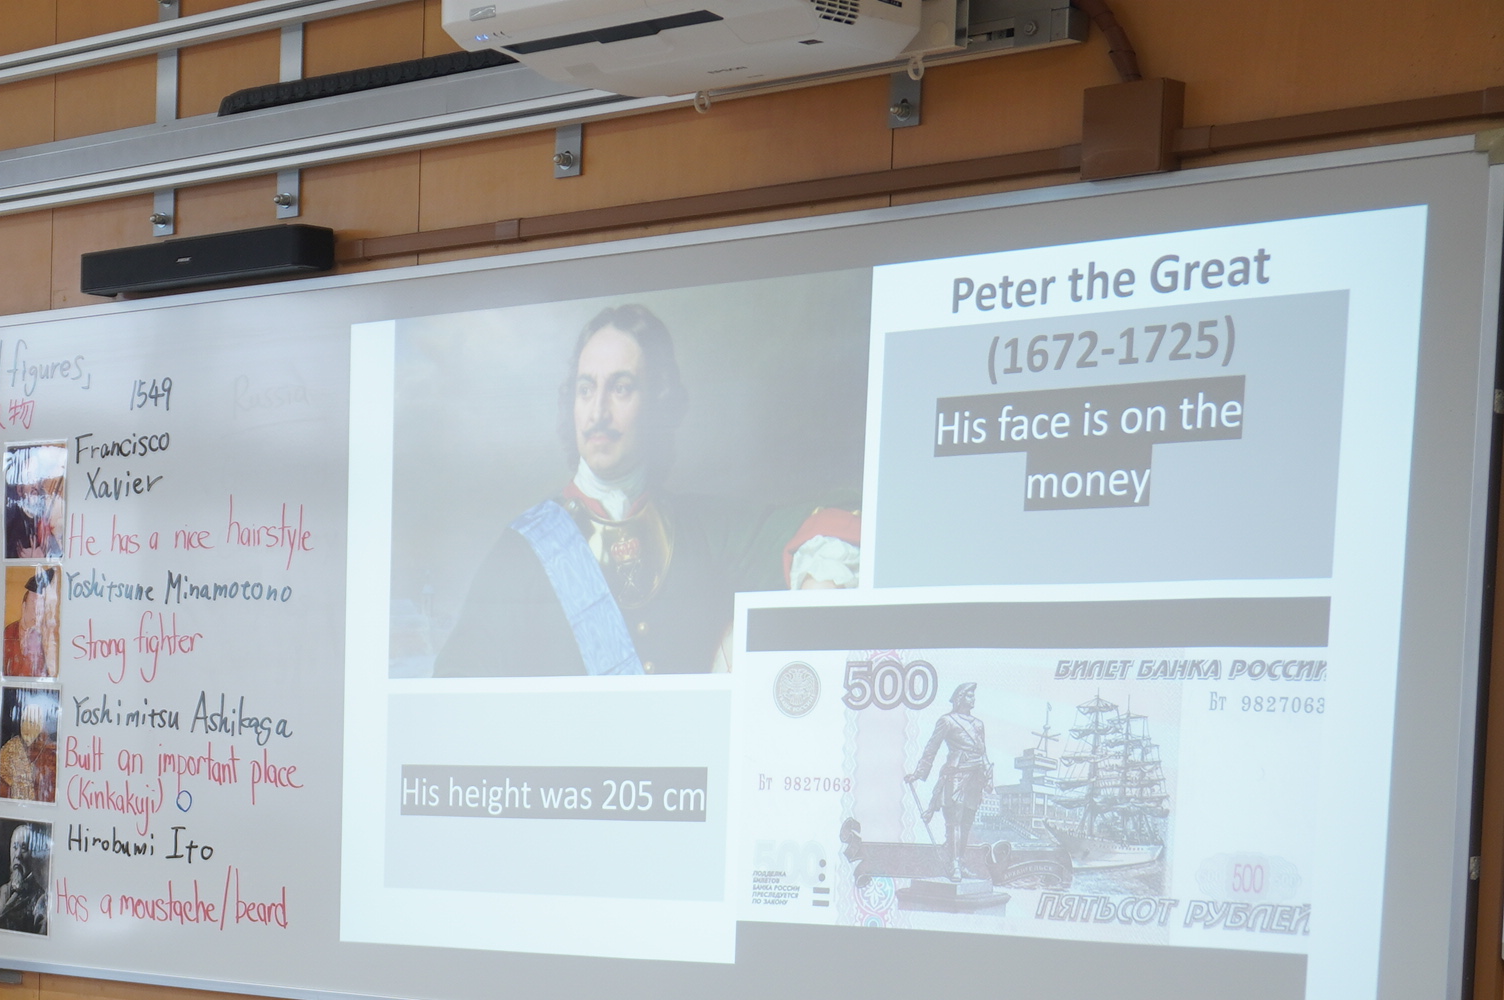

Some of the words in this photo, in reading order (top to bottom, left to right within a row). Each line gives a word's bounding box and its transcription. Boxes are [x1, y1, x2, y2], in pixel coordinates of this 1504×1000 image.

[952, 275, 1056, 314] Peter
[1067, 261, 1136, 303] the
[1150, 247, 1272, 295] Great
[987, 314, 1236, 385] (1672-1725)
[129, 377, 173, 412] 1549
[936, 409, 987, 446] His
[997, 405, 1070, 442] face
[1082, 402, 1109, 437] is
[1120, 405, 1167, 434] on
[1179, 392, 1243, 431] the
[75, 432, 170, 464] Francisco
[85, 467, 163, 500] Xavier
[1026, 468, 1151, 504] money
[68, 512, 101, 559] He
[110, 513, 141, 555] has
[149, 530, 160, 551] a
[174, 523, 215, 551] nice
[226, 496, 315, 571] hairstyle
[65, 567, 155, 602] Yoshitsune
[164, 569, 292, 605] Minamotono
[71, 618, 127, 684] strong
[133, 610, 204, 684] fighter
[841, 659, 939, 711] 500
[1054, 659, 1135, 681] БИЛЕТ
[1136, 659, 1222, 681] БАНКА
[1241, 695, 1325, 714] 9827063
[72, 693, 180, 731] Yoshimitsu
[190, 690, 293, 746] Ashikaga
[64, 735, 104, 773] Built
[117, 748, 143, 775] an
[157, 740, 240, 796] important
[249, 747, 304, 806] place
[784, 776, 852, 793] 9827063
[66, 773, 164, 837] (Kinkakuji)
[402, 777, 439, 807] His
[448, 777, 532, 815] height
[540, 786, 592, 809] was
[601, 780, 653, 811] 205
[663, 787, 705, 811] cm
[67, 823, 155, 857] Hirobumi
[165, 825, 214, 864] Ito
[1232, 863, 1264, 893] 500
[55, 877, 89, 923] Has
[99, 893, 113, 919] a
[1034, 892, 1179, 927] ПЯТЬСОТ
